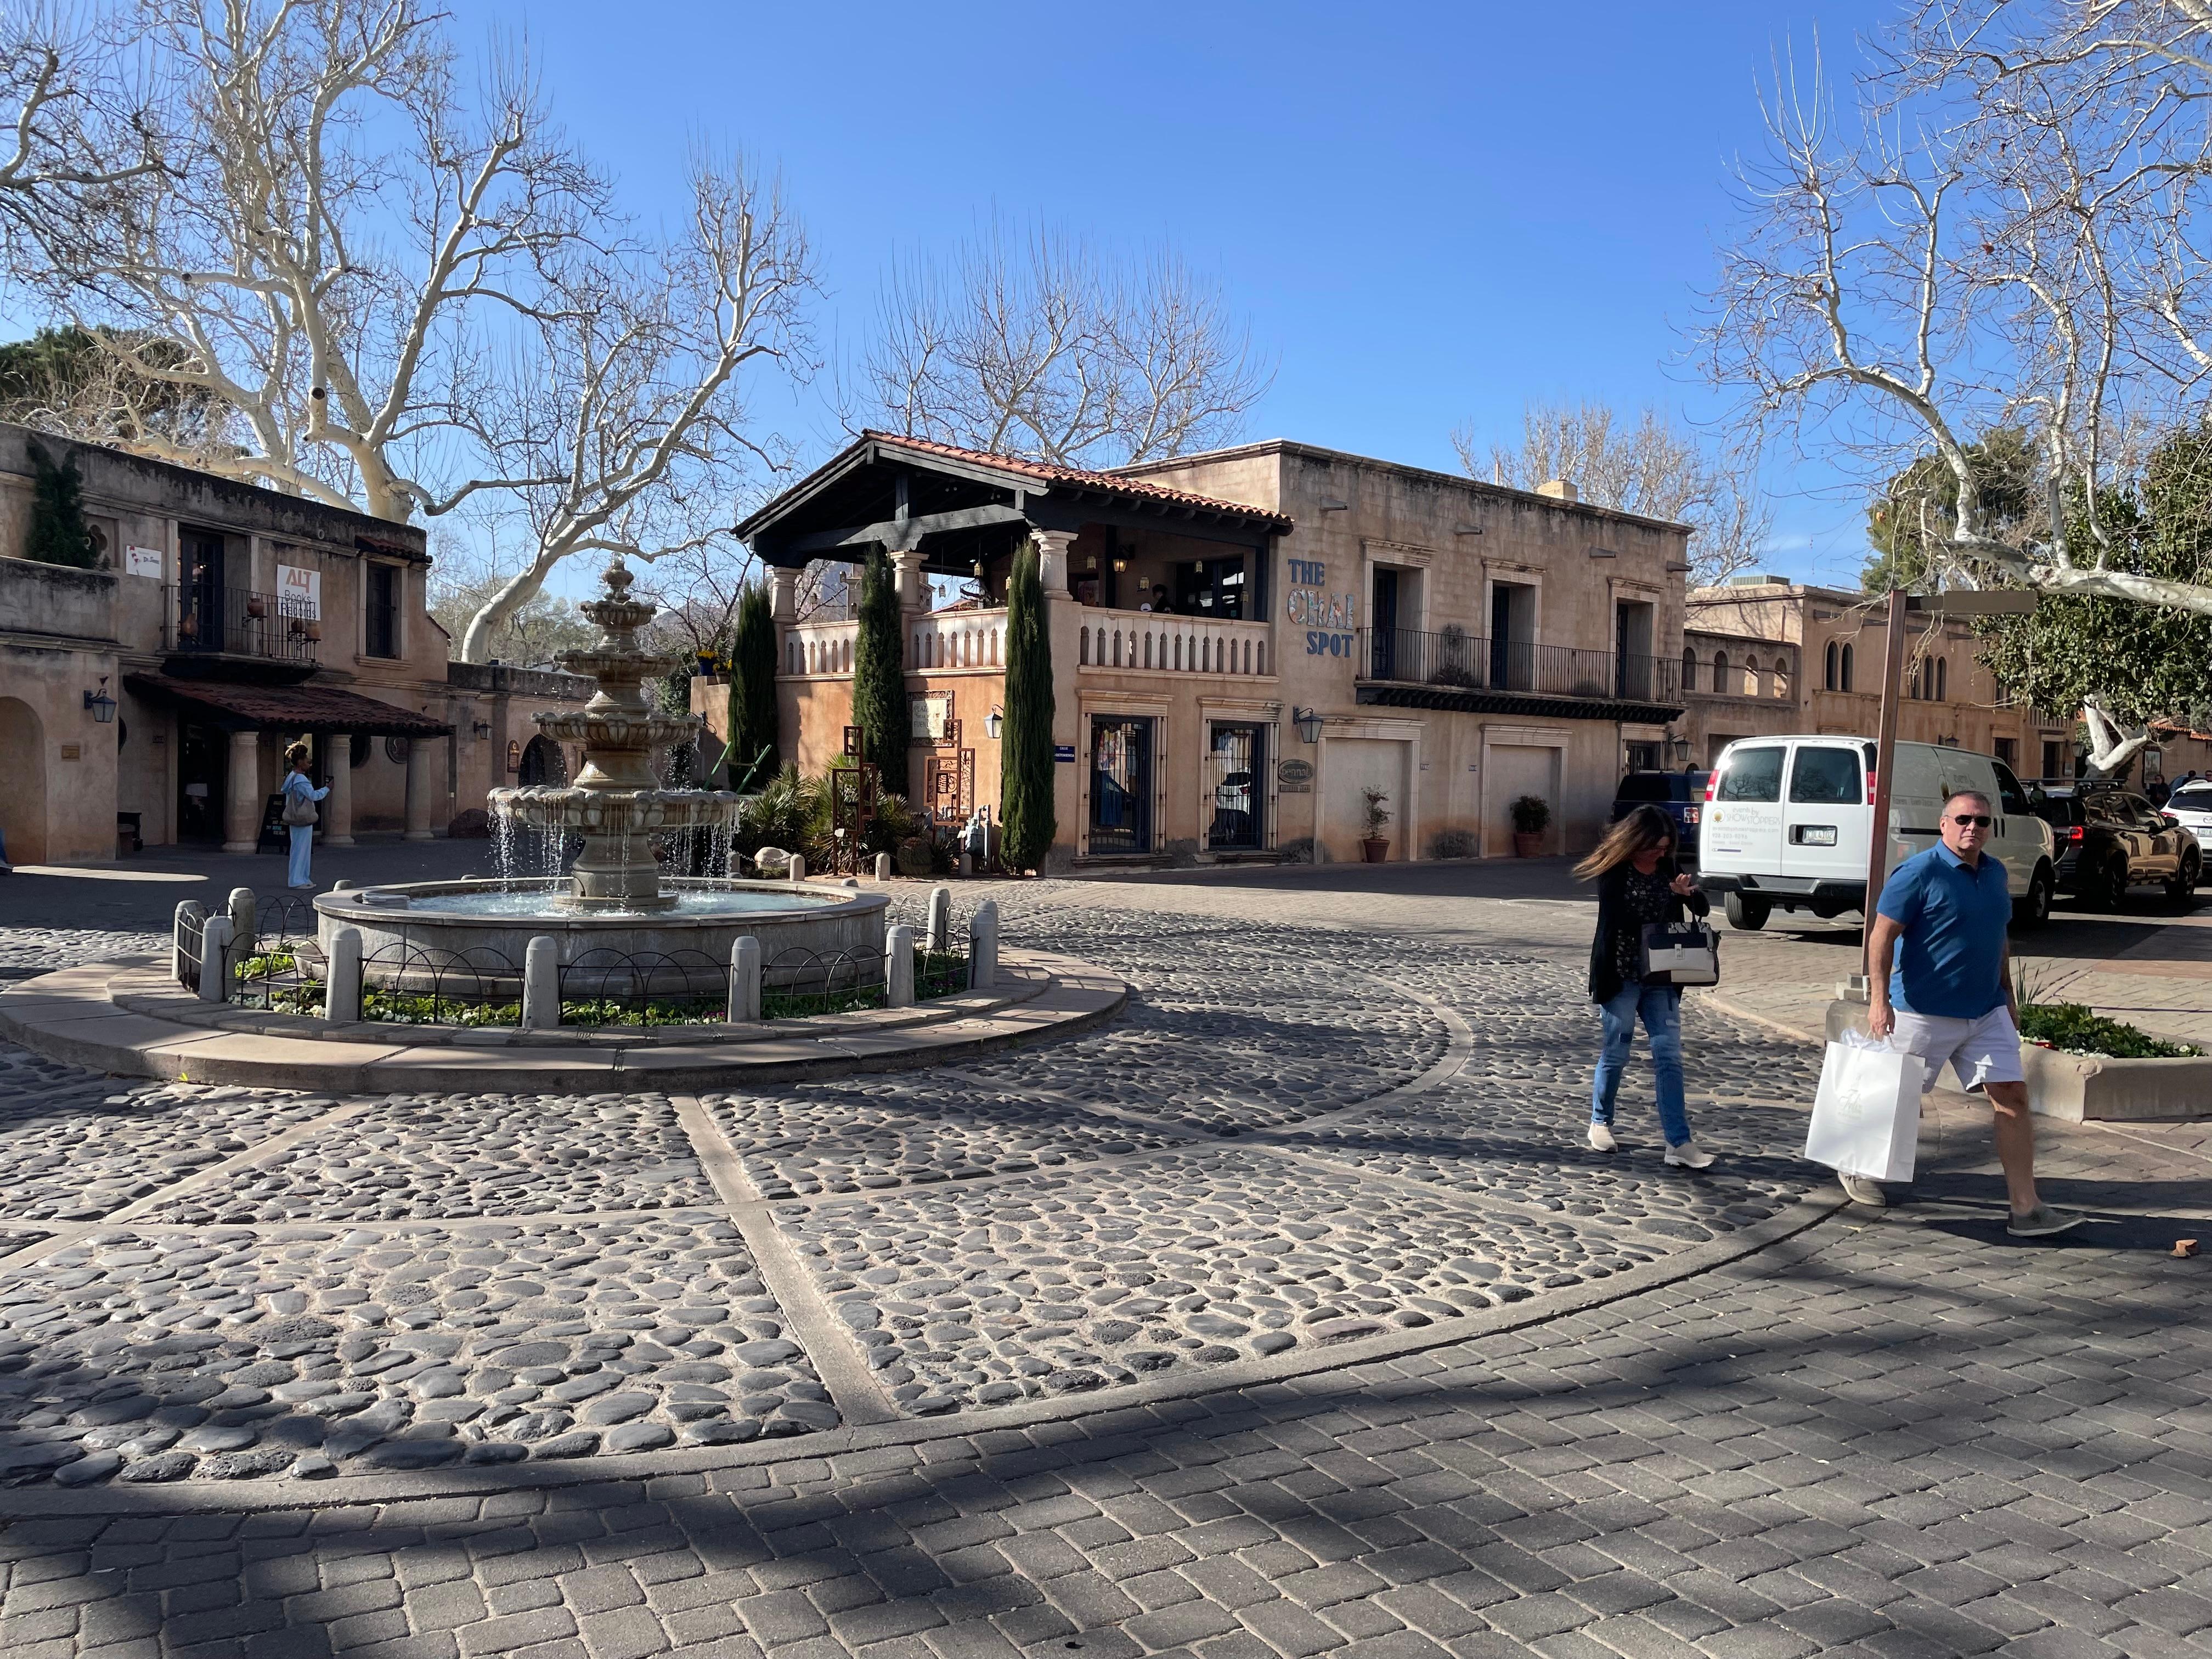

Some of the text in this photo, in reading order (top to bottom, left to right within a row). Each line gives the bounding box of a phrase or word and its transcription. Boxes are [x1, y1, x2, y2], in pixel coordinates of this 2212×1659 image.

[286, 568, 312, 593] ALT
[1288, 558, 1325, 586] THE
[285, 589, 311, 603] Books
[281, 602, 316, 618] Records
[1288, 588, 1354, 630] CHAI
[1306, 631, 1354, 658] SPOT
[1751, 806, 1759, 816] by
